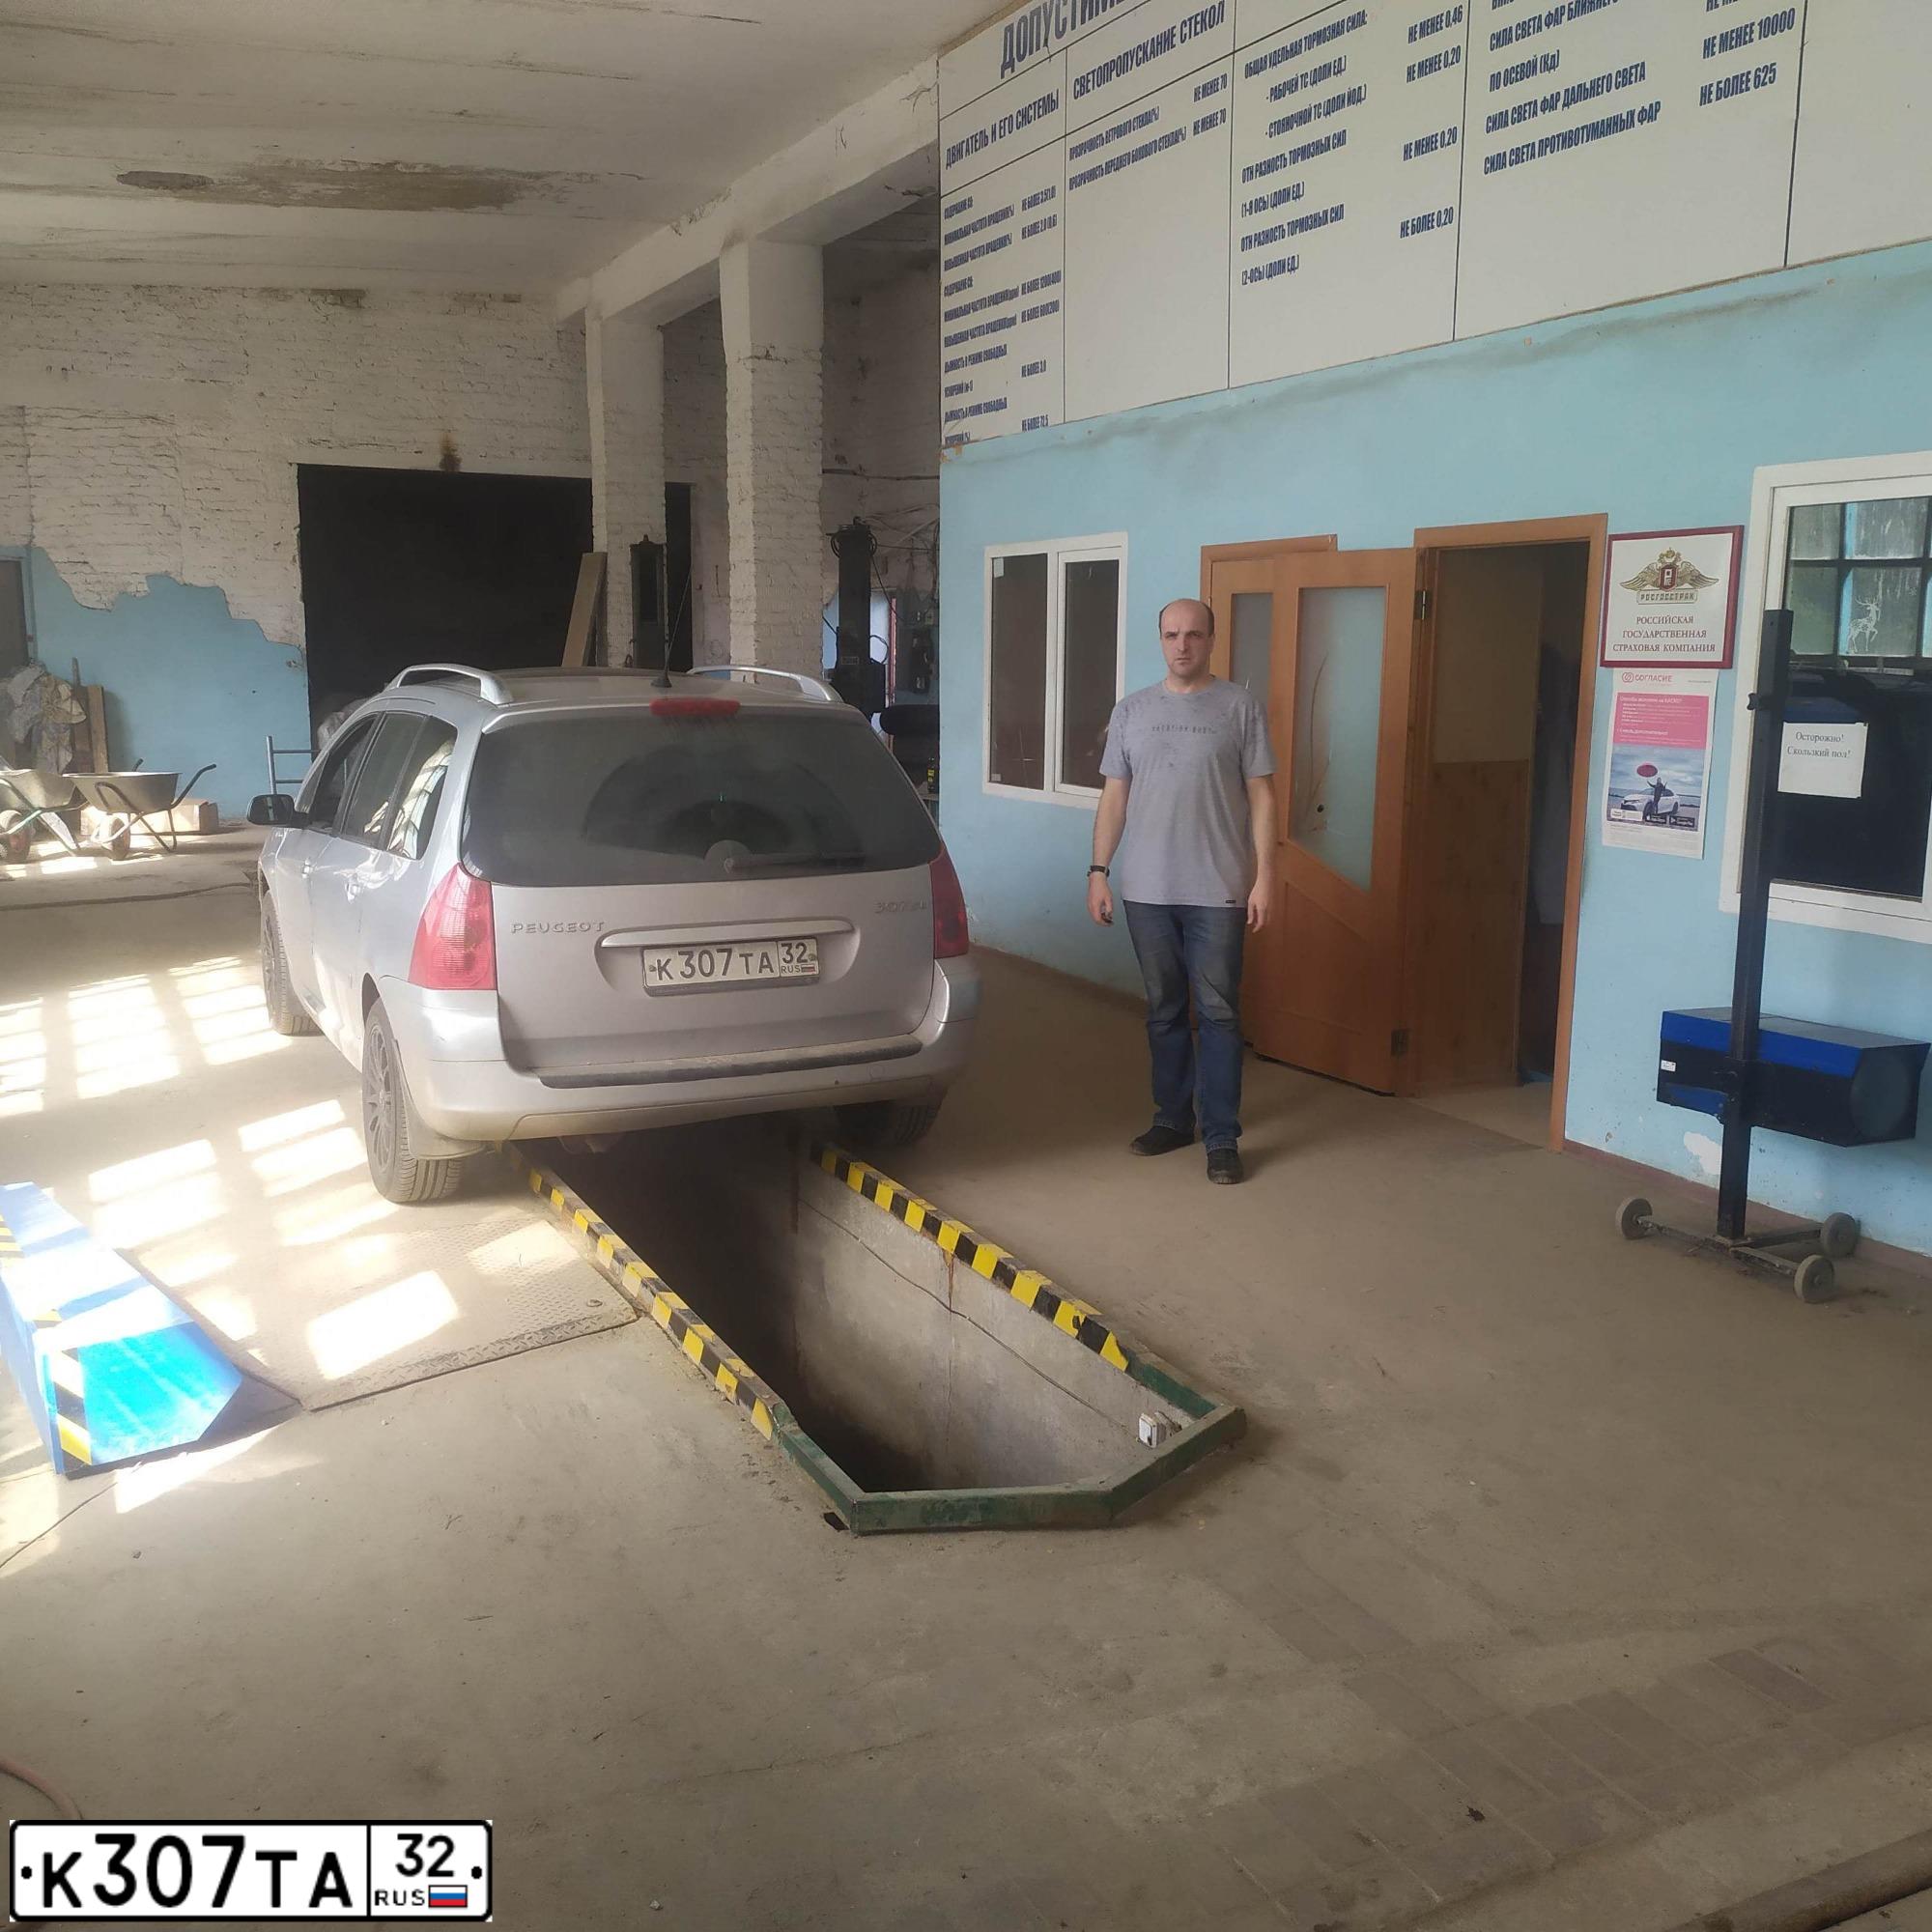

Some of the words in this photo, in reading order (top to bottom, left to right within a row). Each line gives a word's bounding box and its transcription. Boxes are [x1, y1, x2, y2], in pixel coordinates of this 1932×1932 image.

[1407, 23, 1417, 43] НЕ
[1419, 13, 1444, 40] МЕНЕЕ
[1445, 5, 1463, 28] 0,46
[1490, 25, 1513, 51] СИЛА
[1515, 14, 1543, 42] СВЕТА
[1544, 4, 1566, 29] ФАР
[1703, 35, 1717, 59] НЕ
[1719, 21, 1755, 54] МЕНЕЕ
[1757, 8, 1796, 40] 10000
[1073, 25, 1177, 99] СВЕТОПРОПУСКАНИЕ
[1179, 0, 1225, 43] СТЕКОЛ
[1244, 54, 1267, 79] ОБЩАЯ
[1268, 38, 1302, 70] УДЕЛЬНАЯ
[1303, 18, 1345, 52] ТОРМОЗНАЯ
[1406, 64, 1416, 83] НЕ
[1417, 52, 1442, 79] МЕНЕЕ
[1443, 44, 1461, 69] 0,20
[1300, 72, 1309, 90] ТС
[1490, 71, 1501, 93] ПО
[1503, 55, 1538, 87] ОСЕВОЙ
[1699, 83, 1714, 106] НЕ
[1716, 71, 1751, 101] БОЛЕЕ
[1753, 62, 1776, 89] 625
[1194, 85, 1201, 102] НЕ
[1486, 109, 1509, 134] СИЛА
[1511, 99, 1538, 126] СВЕТА
[1540, 91, 1561, 114] ФАР
[1562, 72, 1612, 111] ДАЛЬНЕГО
[1614, 61, 1646, 90] СВЕТА
[1313, 102, 1321, 121] ТС
[946, 128, 989, 170] ДВИГАТЕЛЬ
[991, 123, 997, 143] И
[999, 114, 1013, 139] ЕГО
[1016, 88, 1059, 130] СИСТЕМЫ
[1193, 120, 1201, 136] НЕ
[1403, 142, 1412, 161] НЕ
[1413, 132, 1438, 157] МЕНЕЕ
[1439, 127, 1457, 149] 0,20
[1484, 151, 1507, 175] СИЛА
[1509, 141, 1536, 167] СВЕТА
[1538, 108, 1635, 158] ПРОТИВОТУМАННЫХ
[1637, 100, 1662, 126] ФАР
[1241, 165, 1254, 184] ОТН
[1255, 153, 1288, 179] РАЗНОСТЬ
[1289, 135, 1331, 166] ТОРМОЗНЫХ
[1331, 129, 1347, 150] СИЛ
[1240, 235, 1253, 252] ОТН
[1254, 223, 1286, 248] РАЗНОСТЬ
[1287, 209, 1328, 237] ТОРМОЗНЫХ
[1329, 204, 1345, 223] СИЛ
[1400, 219, 1409, 239] НЕ
[1410, 212, 1435, 236] БОЛЕЕ
[1436, 207, 1454, 228] 0,20
[1640, 592, 1694, 602] РОСГОССТРАХ
[1623, 629, 1707, 639] ГОСУДАРСТВЕННАЯ
[1636, 614, 1693, 625] РОССИЙСКАЯ
[1612, 643, 1660, 652] СТРАХОВАЯ
[1663, 643, 1716, 652] КОМПАНИЯ
[1634, 674, 1672, 683] СОГЛАСИЕ
[1796, 731, 1845, 744] Осторожно!
[1832, 750, 1851, 758] пол!
[511, 921, 605, 934] PEUGEOT
[781, 942, 809, 964] 32
[781, 965, 801, 974] RUS
